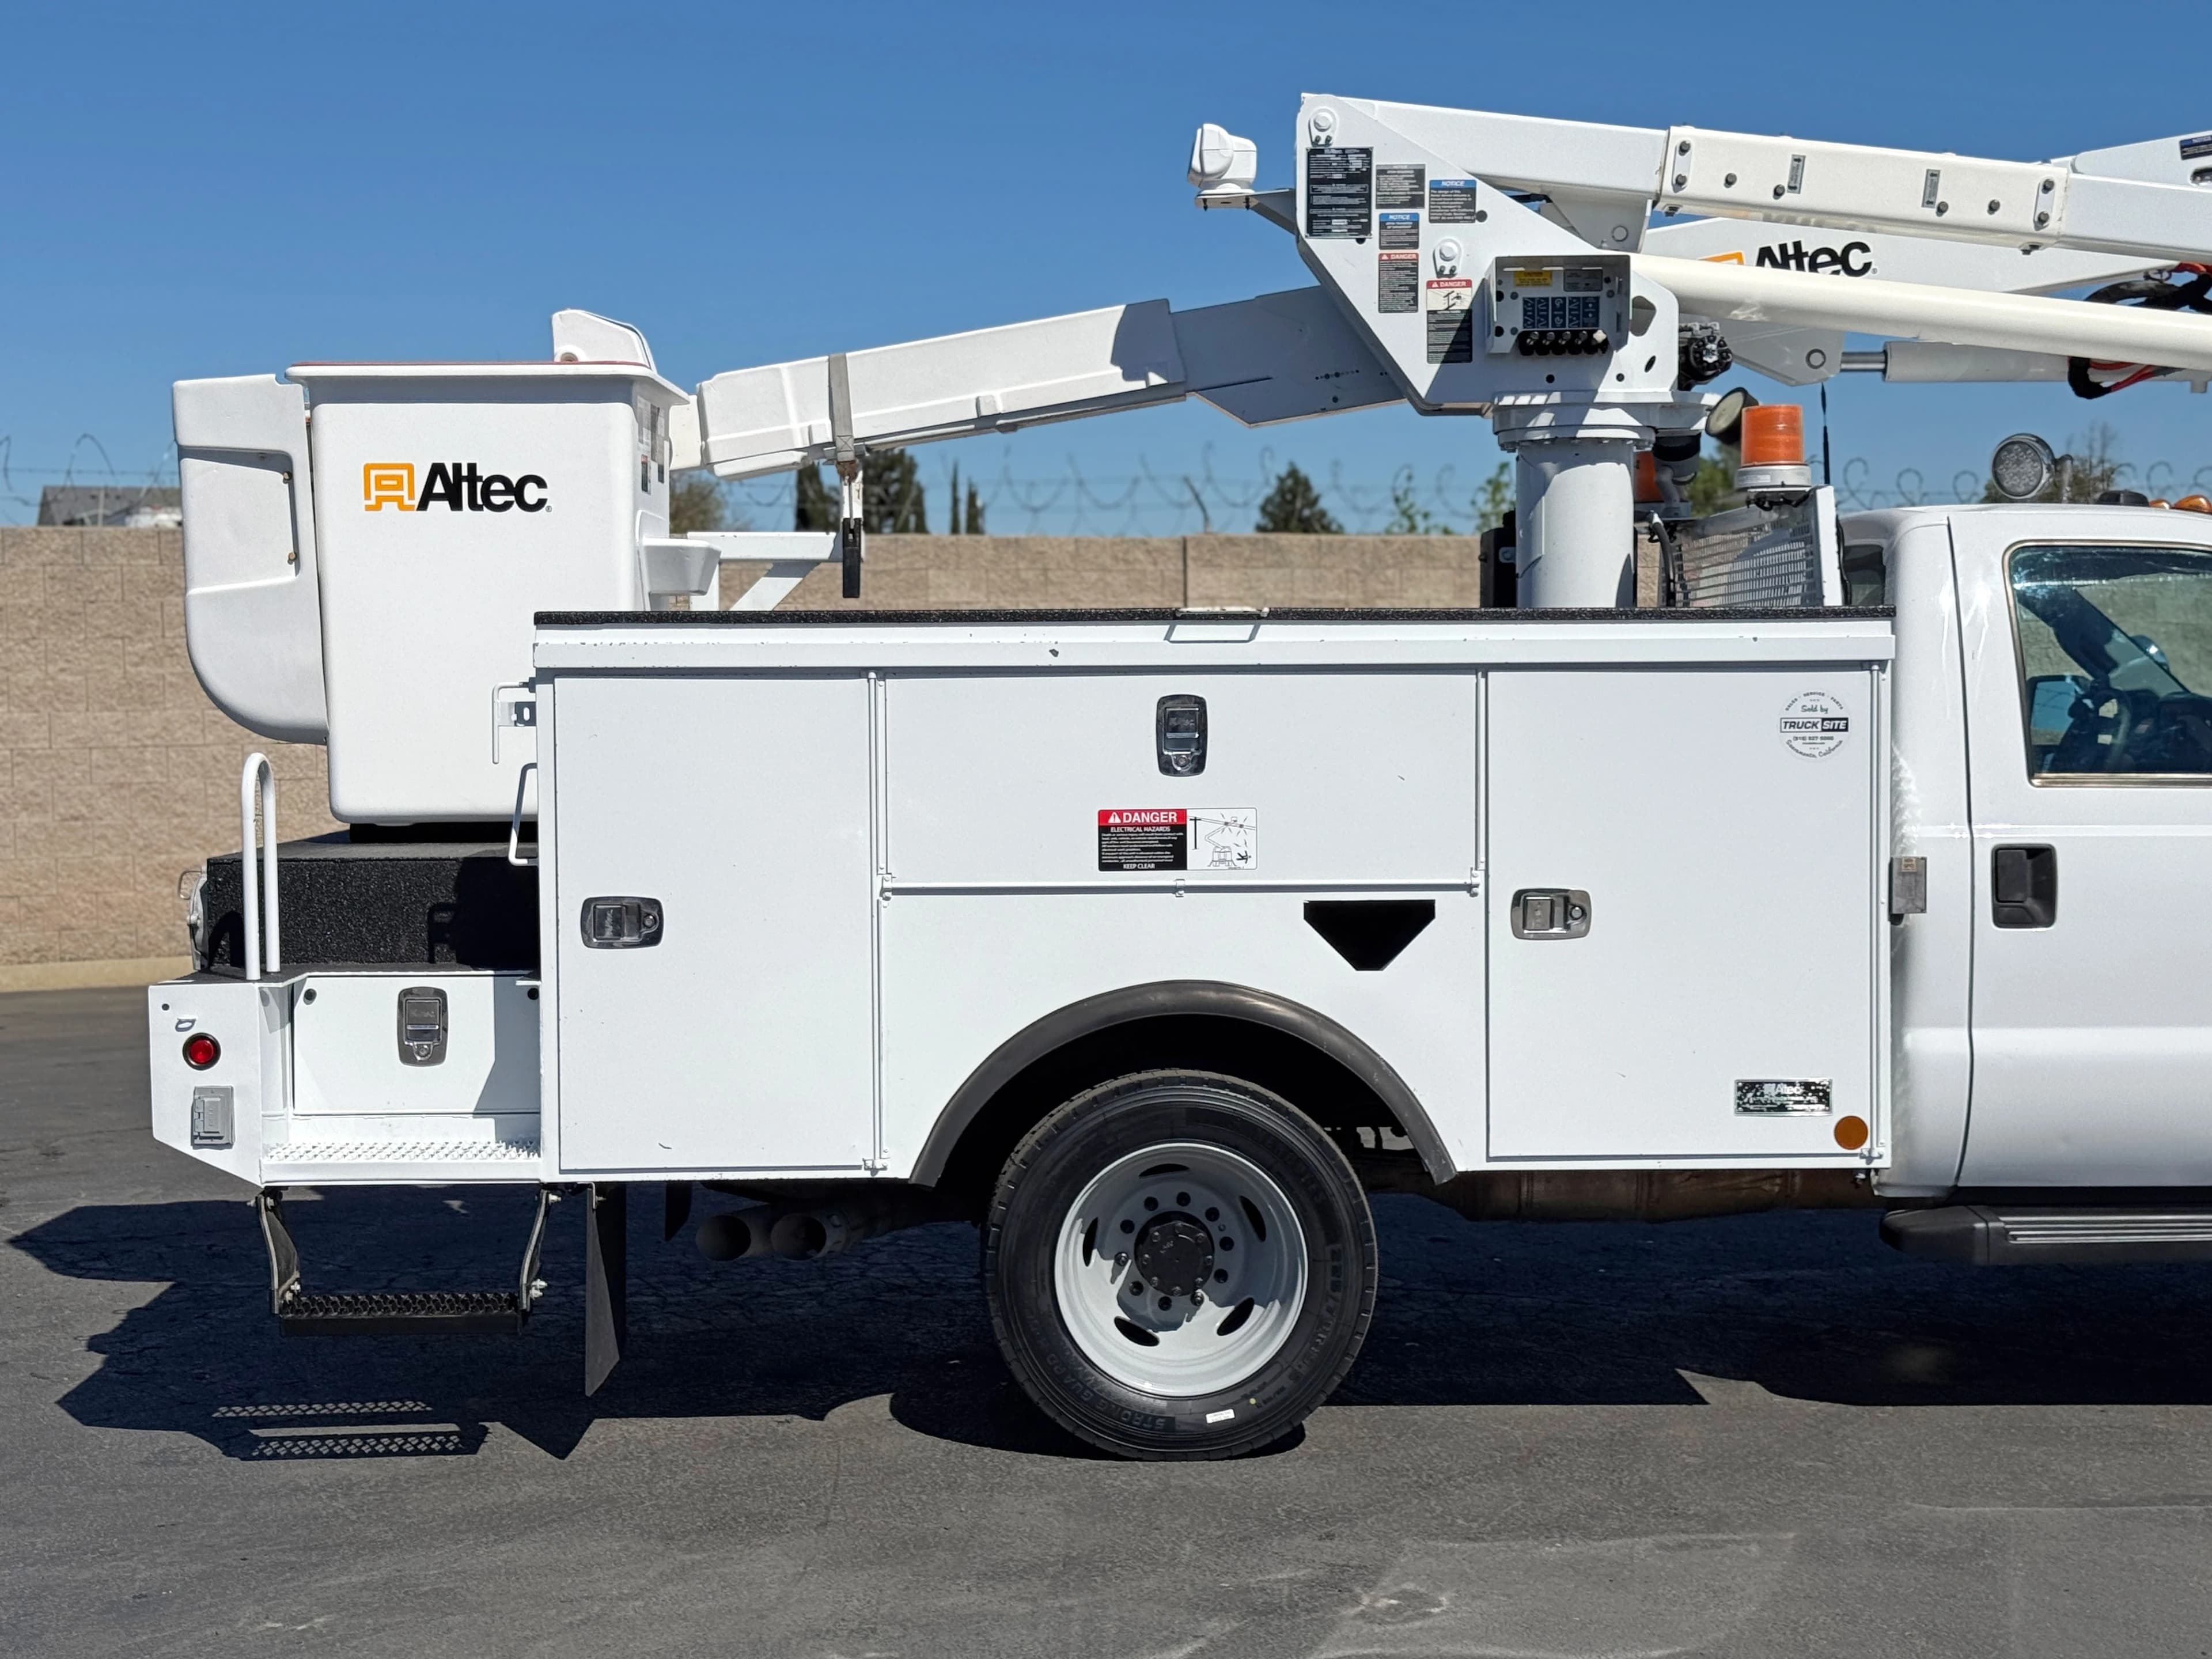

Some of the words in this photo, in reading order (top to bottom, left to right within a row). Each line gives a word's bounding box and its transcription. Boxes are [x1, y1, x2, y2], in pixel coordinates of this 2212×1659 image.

[1755, 240, 1872, 278] Altec
[416, 462, 548, 513] Altec
[1801, 704, 1818, 713] Sold
[1820, 704, 1829, 714] by
[1783, 721, 1820, 730] TRUCK
[1822, 720, 1847, 730] SITE
[1123, 812, 1177, 823] DANGER
